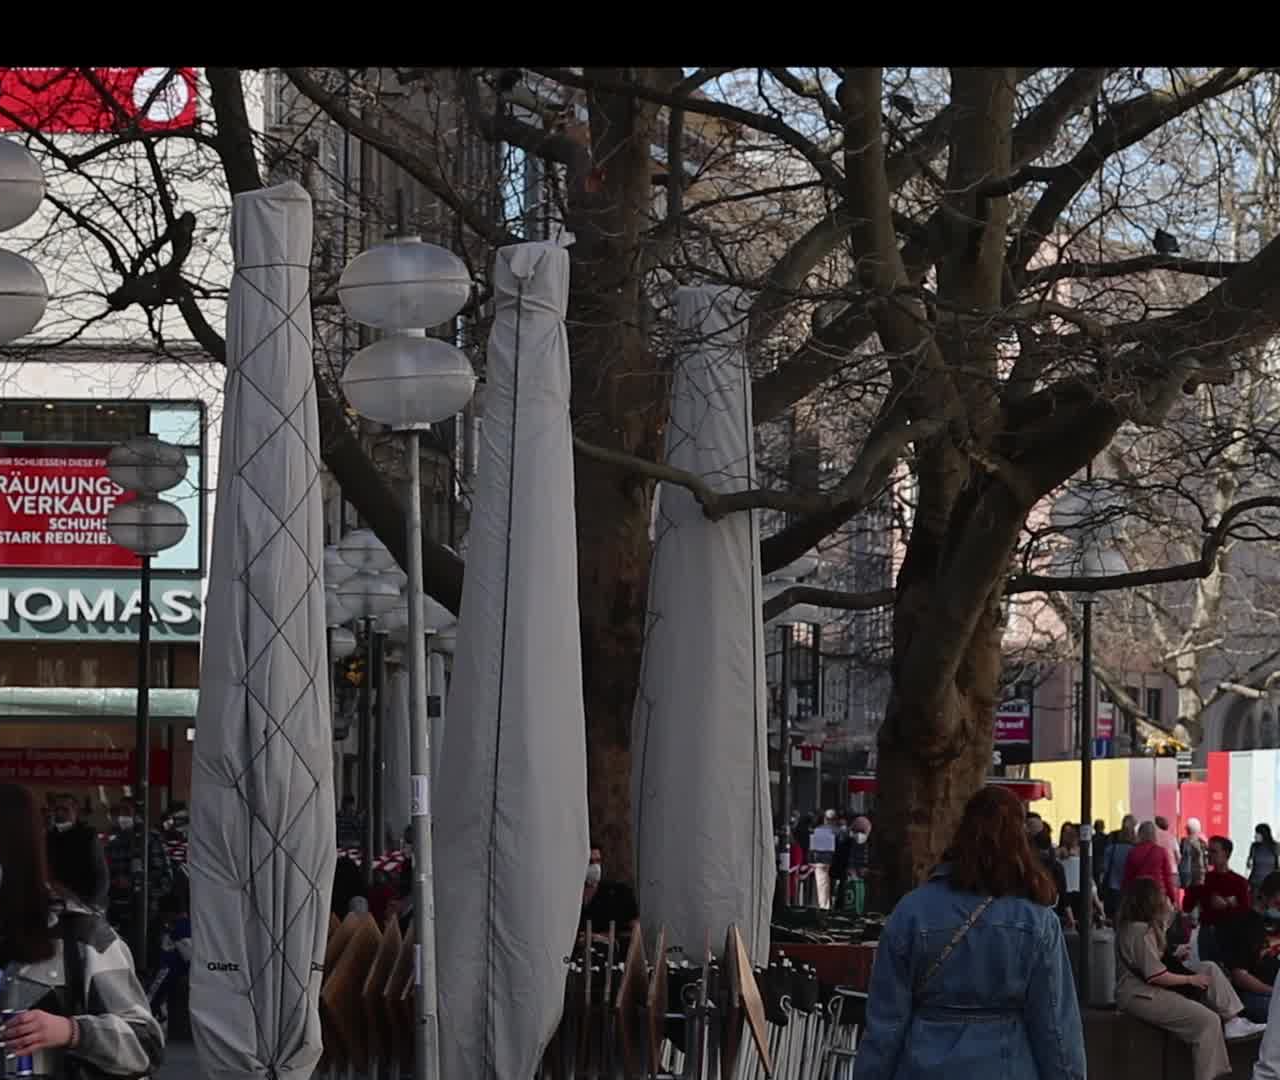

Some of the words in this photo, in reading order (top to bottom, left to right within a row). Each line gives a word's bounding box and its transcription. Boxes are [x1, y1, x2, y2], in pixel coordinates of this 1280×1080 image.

[14, 458, 66, 467] SCHLIESSEN
[68, 459, 92, 467] DIESE
[7, 496, 116, 514] VERKAUF
[207, 961, 240, 972] Glatz
